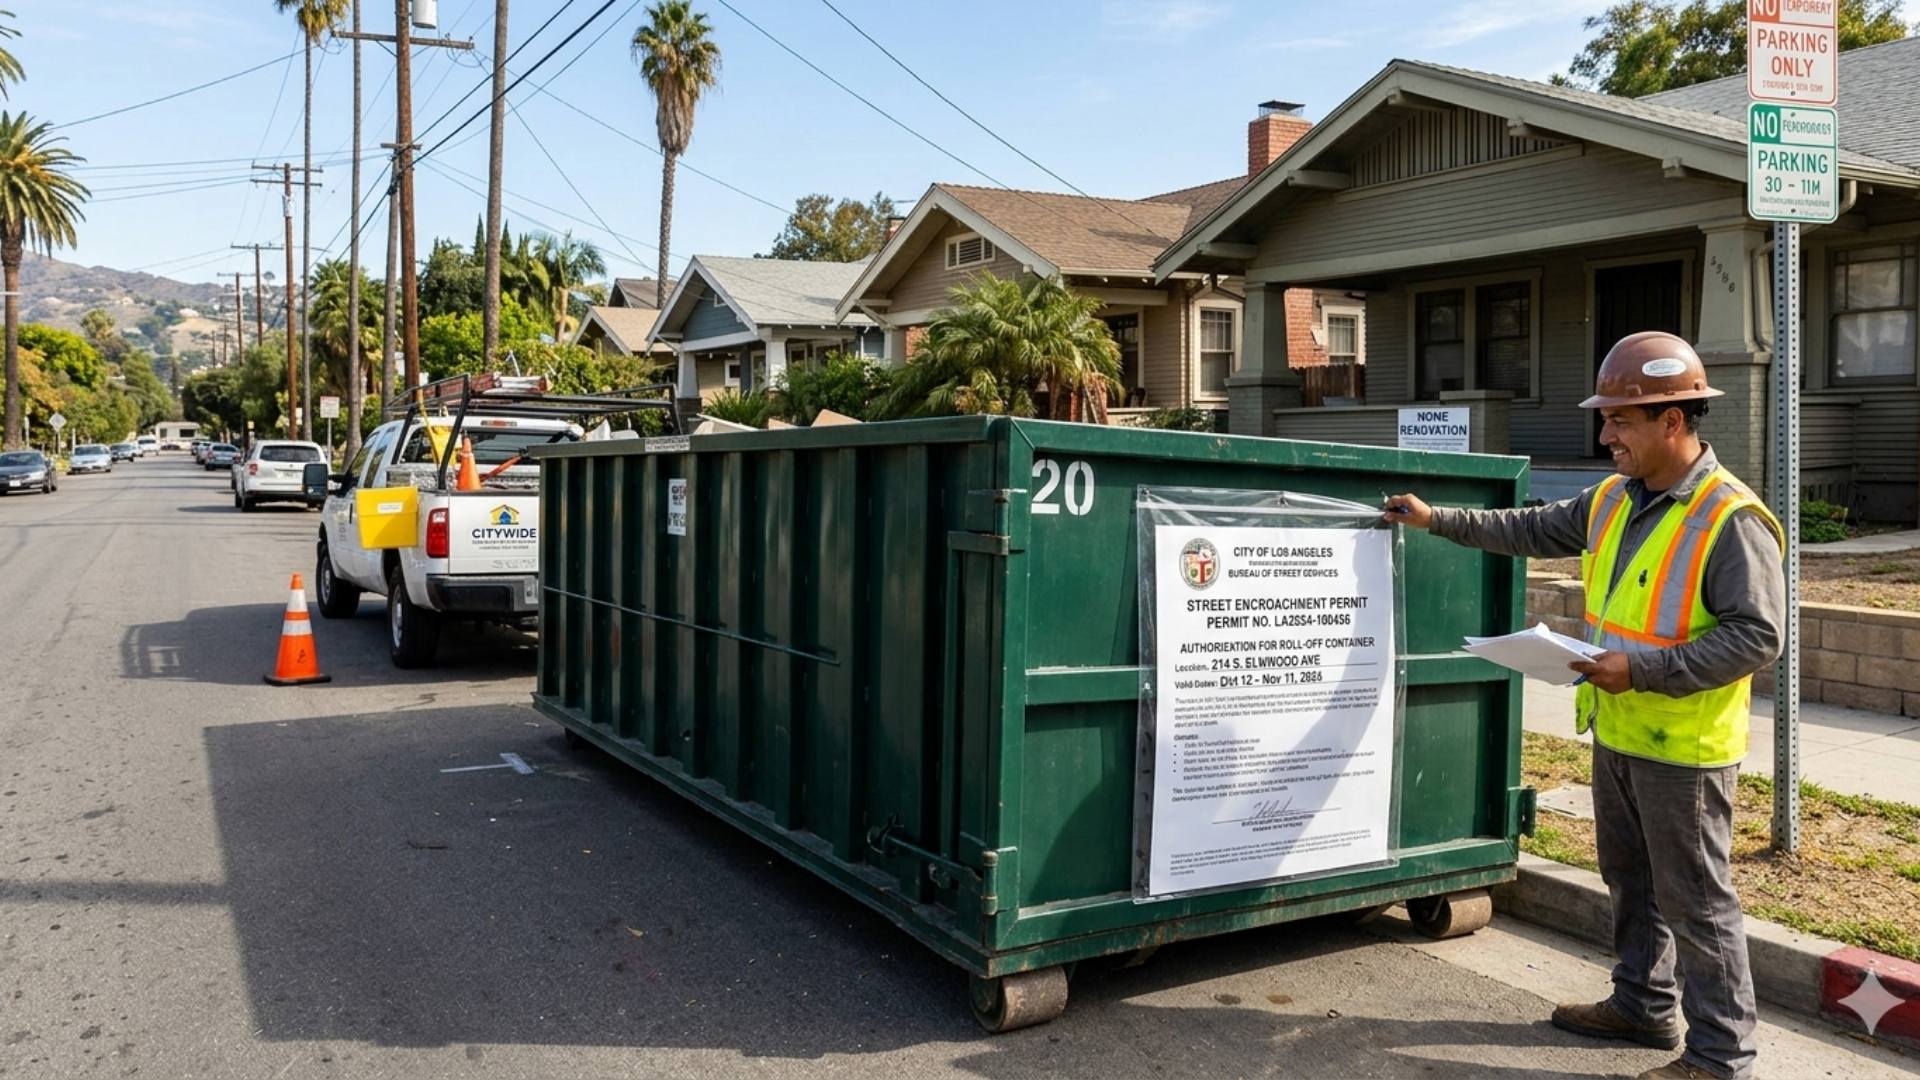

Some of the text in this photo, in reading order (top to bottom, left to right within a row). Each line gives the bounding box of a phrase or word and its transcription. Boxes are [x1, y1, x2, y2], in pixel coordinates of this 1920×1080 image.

[1752, 0, 1777, 16] NO
[1757, 28, 1828, 54] PARKING
[1771, 56, 1814, 78] ONLY
[1753, 111, 1778, 139] NO
[1758, 150, 1829, 174] PARKING
[1765, 176, 1782, 193] 30
[1417, 411, 1449, 422] NONE
[1400, 425, 1467, 435] RENOVATION
[1031, 459, 1094, 516] 20
[472, 528, 536, 538] CITYWIDE
[1233, 547, 1334, 558] CITY OF LOS ANGELES
[1261, 569, 1271, 578] OF
[1187, 599, 1232, 612] STREET
[1207, 616, 1249, 628] PERMIT
[1252, 615, 1272, 627] NO.
[1259, 640, 1277, 651] FOR
[1279, 638, 1323, 650] ROLL-OFF
[1325, 636, 1375, 648] CONTAINER
[1211, 658, 1230, 670] 214
[1232, 657, 1243, 668] S.
[1300, 654, 1321, 666] AVE
[1241, 674, 1253, 685] 12
[1284, 672, 1298, 684] 11,
